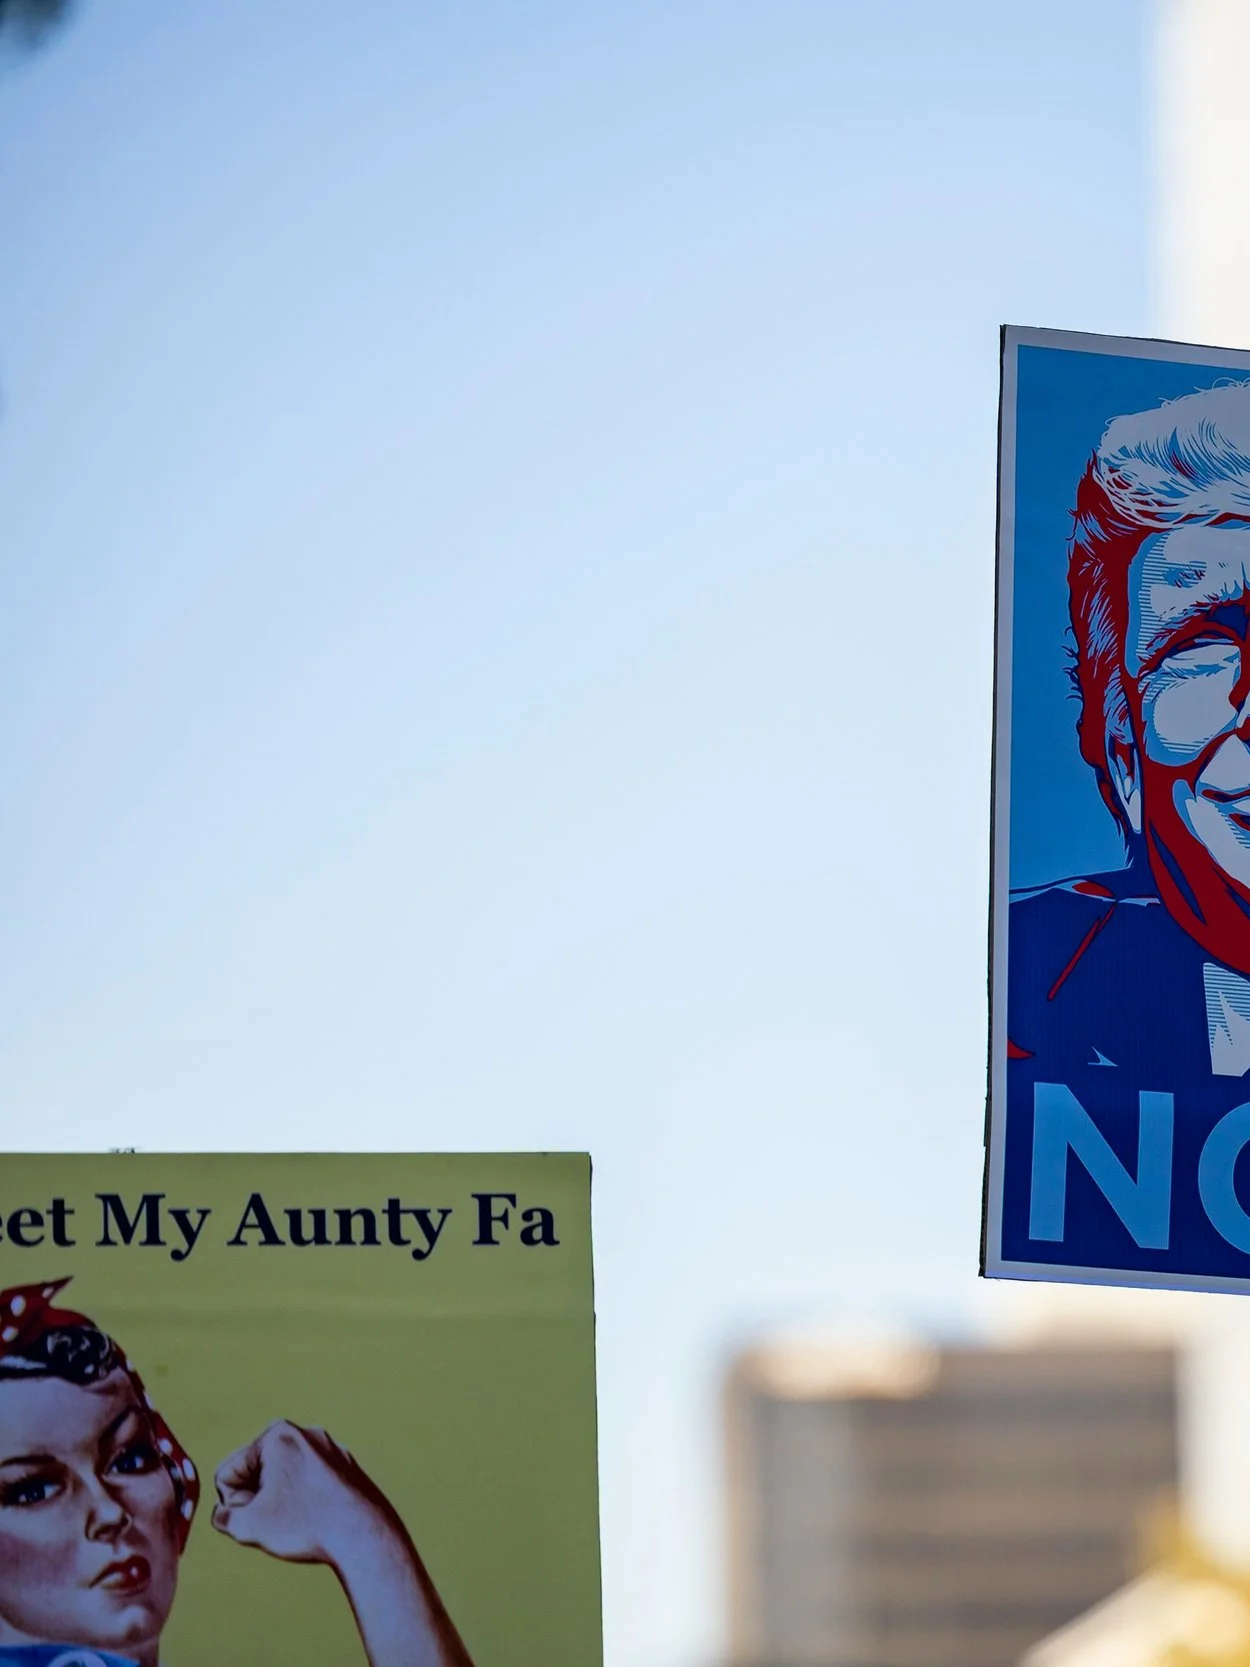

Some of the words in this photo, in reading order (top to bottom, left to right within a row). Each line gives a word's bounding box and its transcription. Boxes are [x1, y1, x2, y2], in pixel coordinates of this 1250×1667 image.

[0, 1197, 76, 1248] et
[94, 1192, 213, 1263] My
[226, 1192, 454, 1264] Aunty
[470, 1192, 561, 1248] Fa
